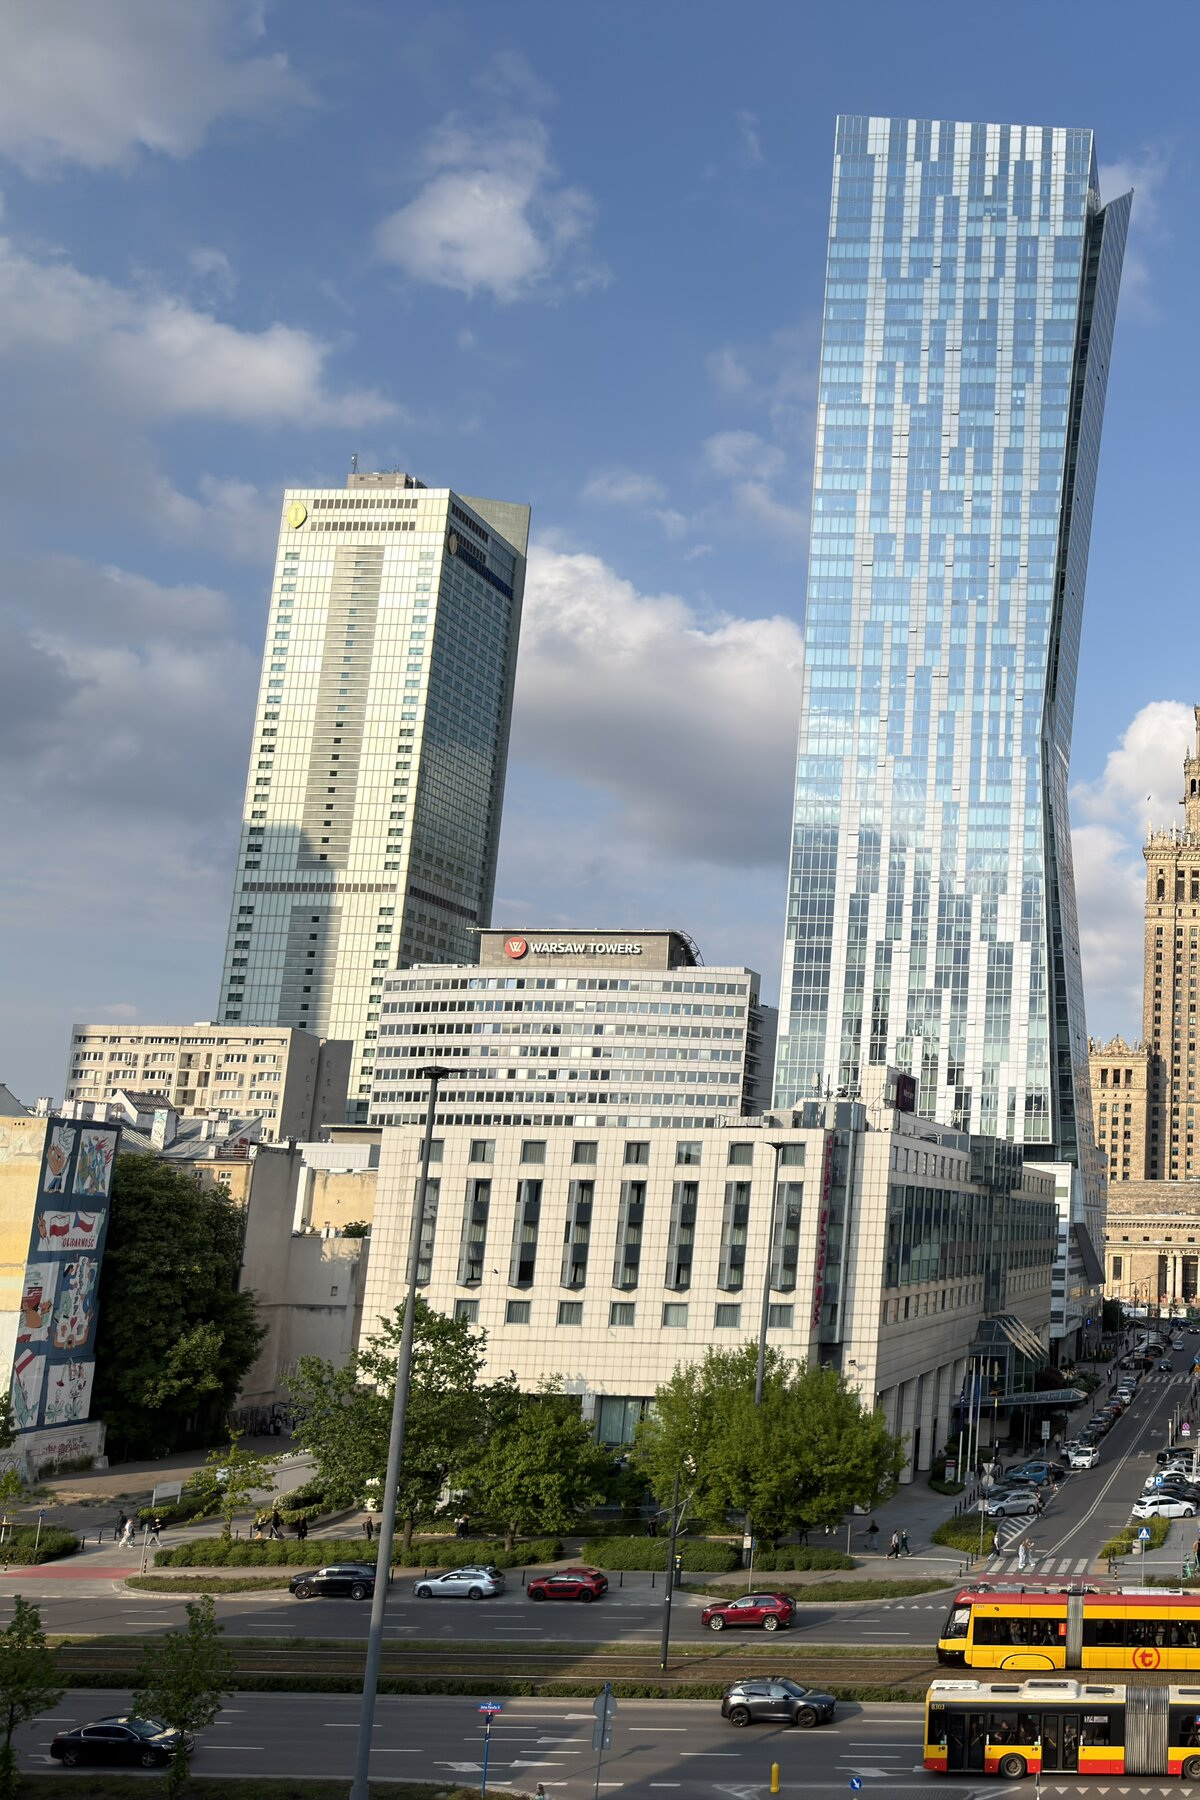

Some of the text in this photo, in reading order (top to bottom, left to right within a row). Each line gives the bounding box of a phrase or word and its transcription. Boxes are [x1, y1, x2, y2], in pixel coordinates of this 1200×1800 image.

[530, 942, 642, 954] WARSAW TOWERS
[62, 1235, 96, 1248] OLIDARNOŚĆ
